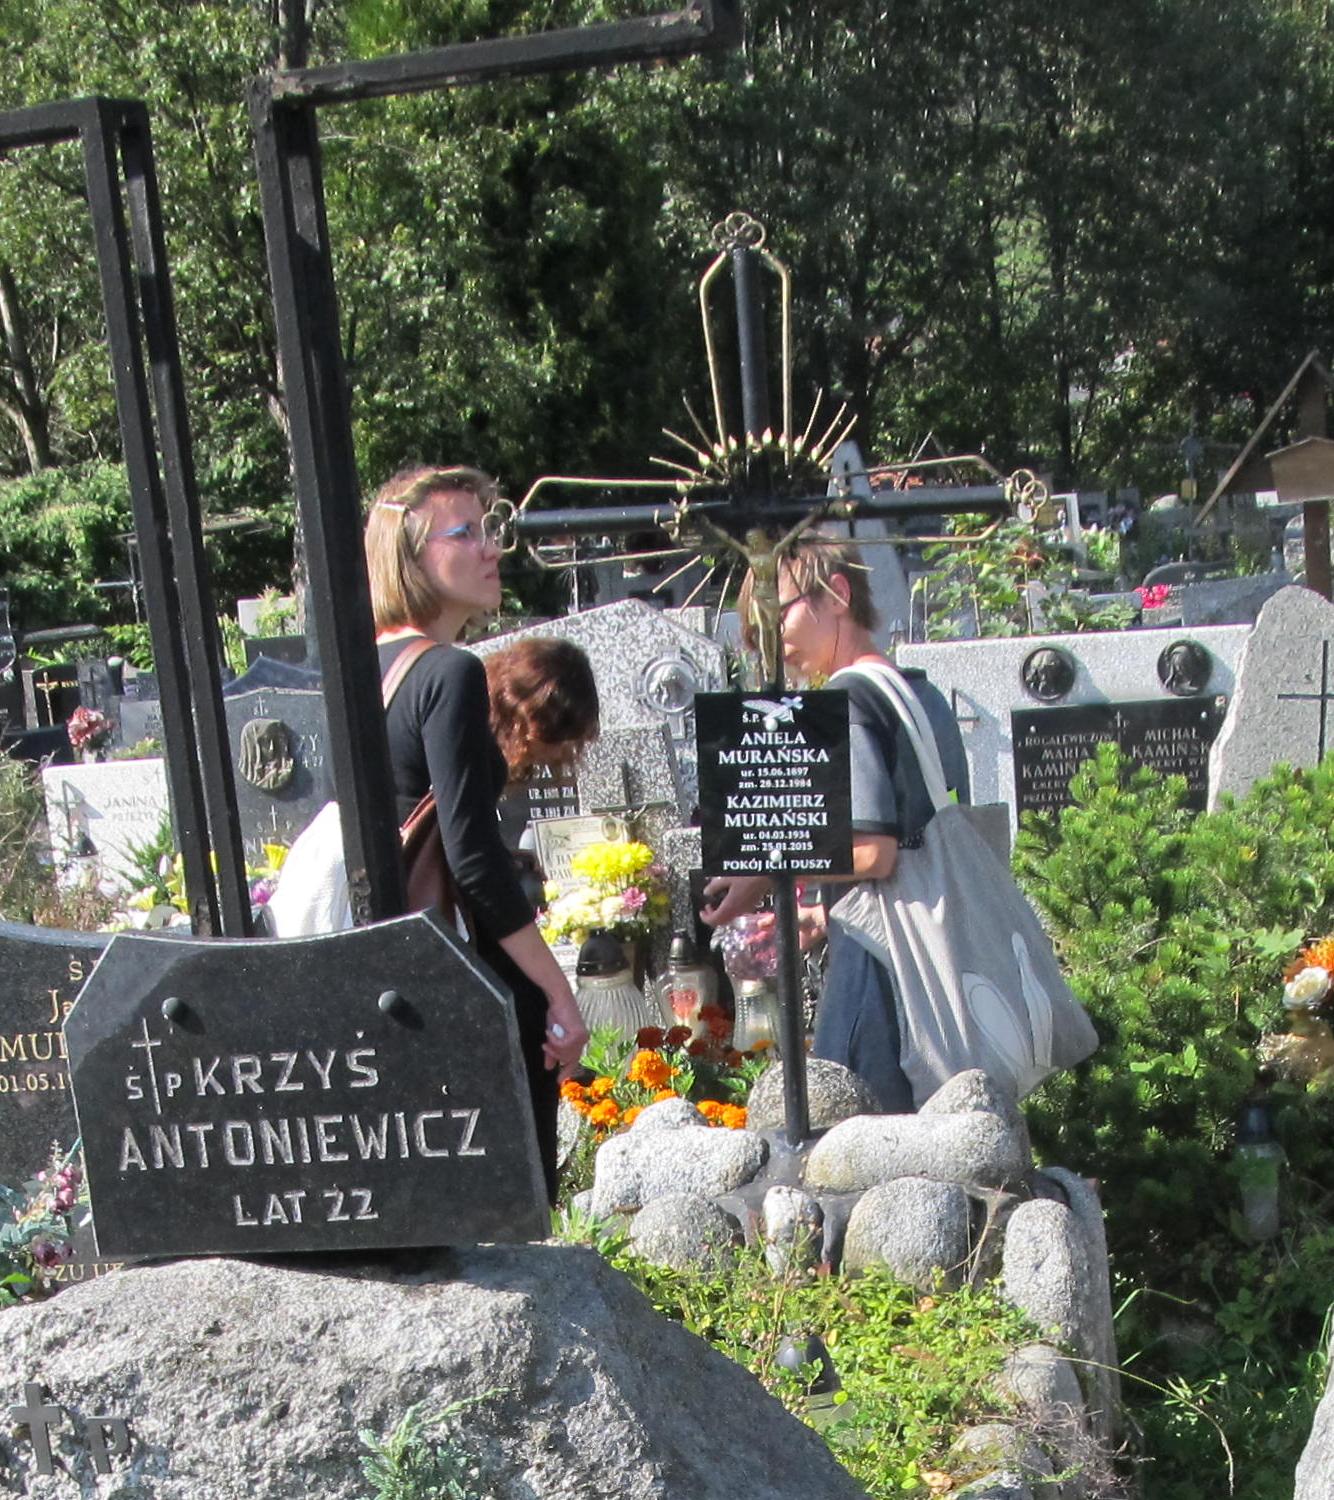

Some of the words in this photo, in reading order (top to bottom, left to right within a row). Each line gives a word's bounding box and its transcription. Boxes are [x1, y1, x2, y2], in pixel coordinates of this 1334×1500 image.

[740, 731, 807, 745] ANIELA
[1144, 726, 1200, 741] MICHAŁ
[718, 746, 830, 765] MURAŃSKA
[1042, 747, 1090, 760] MARIA
[1132, 741, 1212, 758] KAMIŃSK
[741, 769, 755, 777] ur.
[739, 781, 758, 789] zm.
[726, 794, 825, 809] KAZIMIERZ
[724, 809, 828, 827] MURAŃSKI
[742, 833, 757, 841] ur.
[740, 844, 760, 852] zm.
[723, 858, 763, 872] POKÓJ
[791, 859, 833, 870] DUSZY
[194, 1030, 379, 1098] KRZYŚ
[125, 1065, 142, 1101] Ś
[166, 1071, 183, 1098] P
[118, 1108, 487, 1172] ANTONIEWICZ
[234, 1189, 306, 1227] LAT
[323, 1188, 380, 1224] 22
[54, 1264, 85, 1282] ZU
[86, 1416, 131, 1474] P
